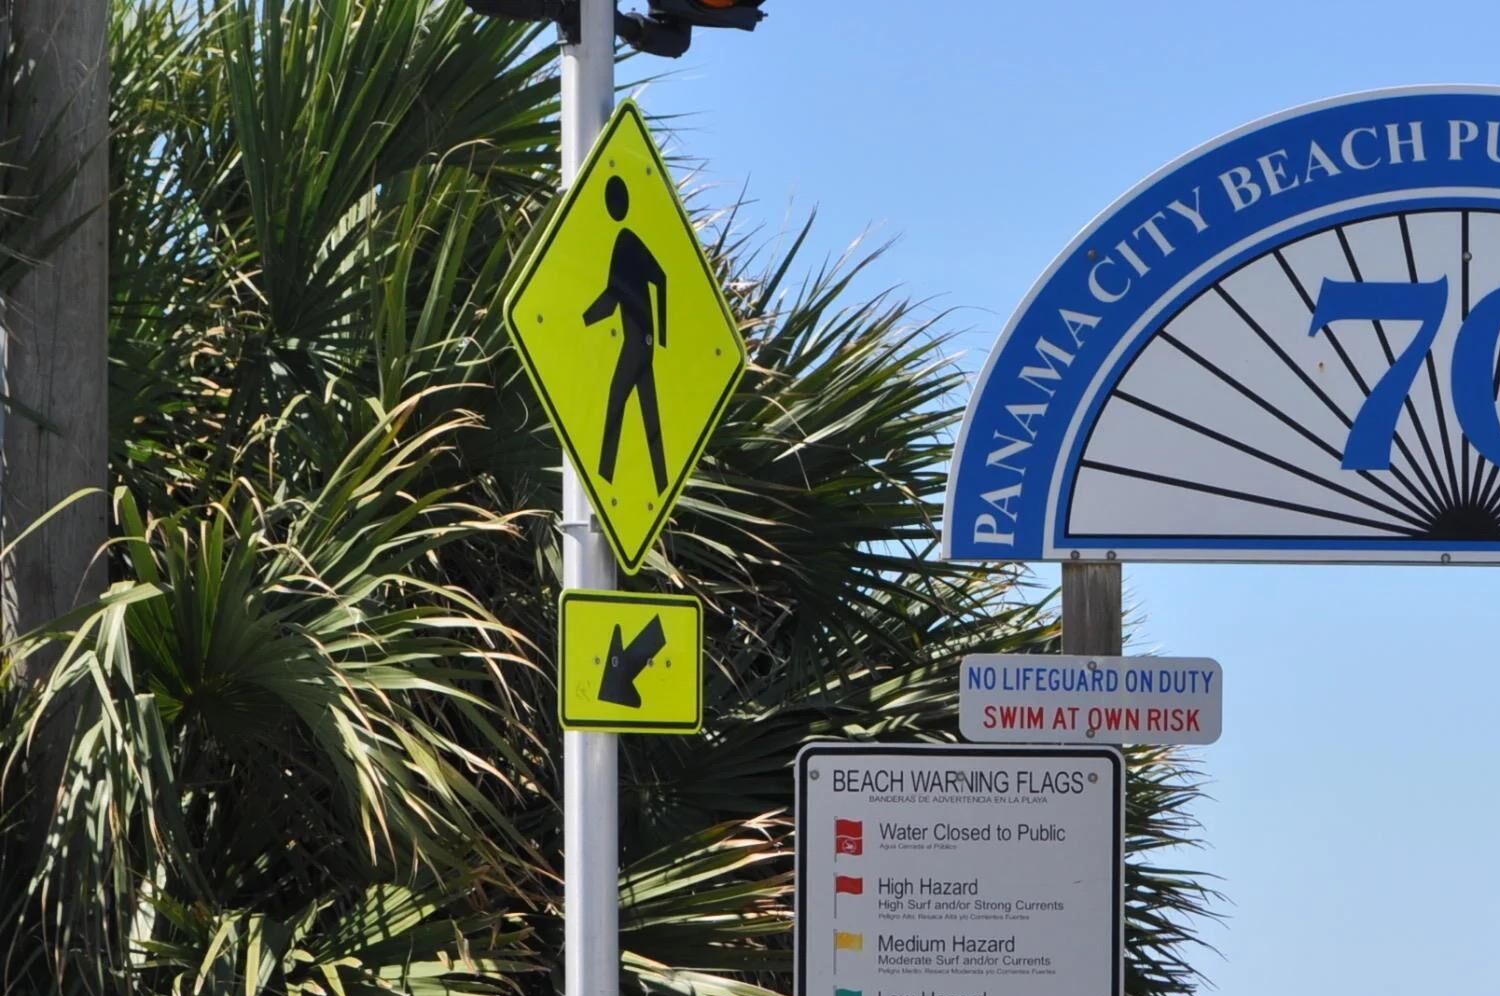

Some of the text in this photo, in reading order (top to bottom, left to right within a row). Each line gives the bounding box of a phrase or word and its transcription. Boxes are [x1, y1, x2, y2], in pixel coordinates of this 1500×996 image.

[971, 312, 1106, 548] PANAMA
[1085, 185, 1210, 300] CITY
[1219, 121, 1426, 213] BEACH
[968, 667, 1214, 694] NO LIFEGUARD ON DUTY
[983, 705, 1201, 732] SWIM AT OWN RISK
[832, 770, 1084, 794] BEACH WARNING FLAGS
[879, 823, 1066, 841] Water Closed to Public
[878, 878, 978, 898] High Hazard
[878, 900, 1065, 912] High Surf and/or Strong Currents
[877, 935, 1015, 953] Medium Hazard
[877, 955, 1052, 966] Moderate Surf and/or Currents
